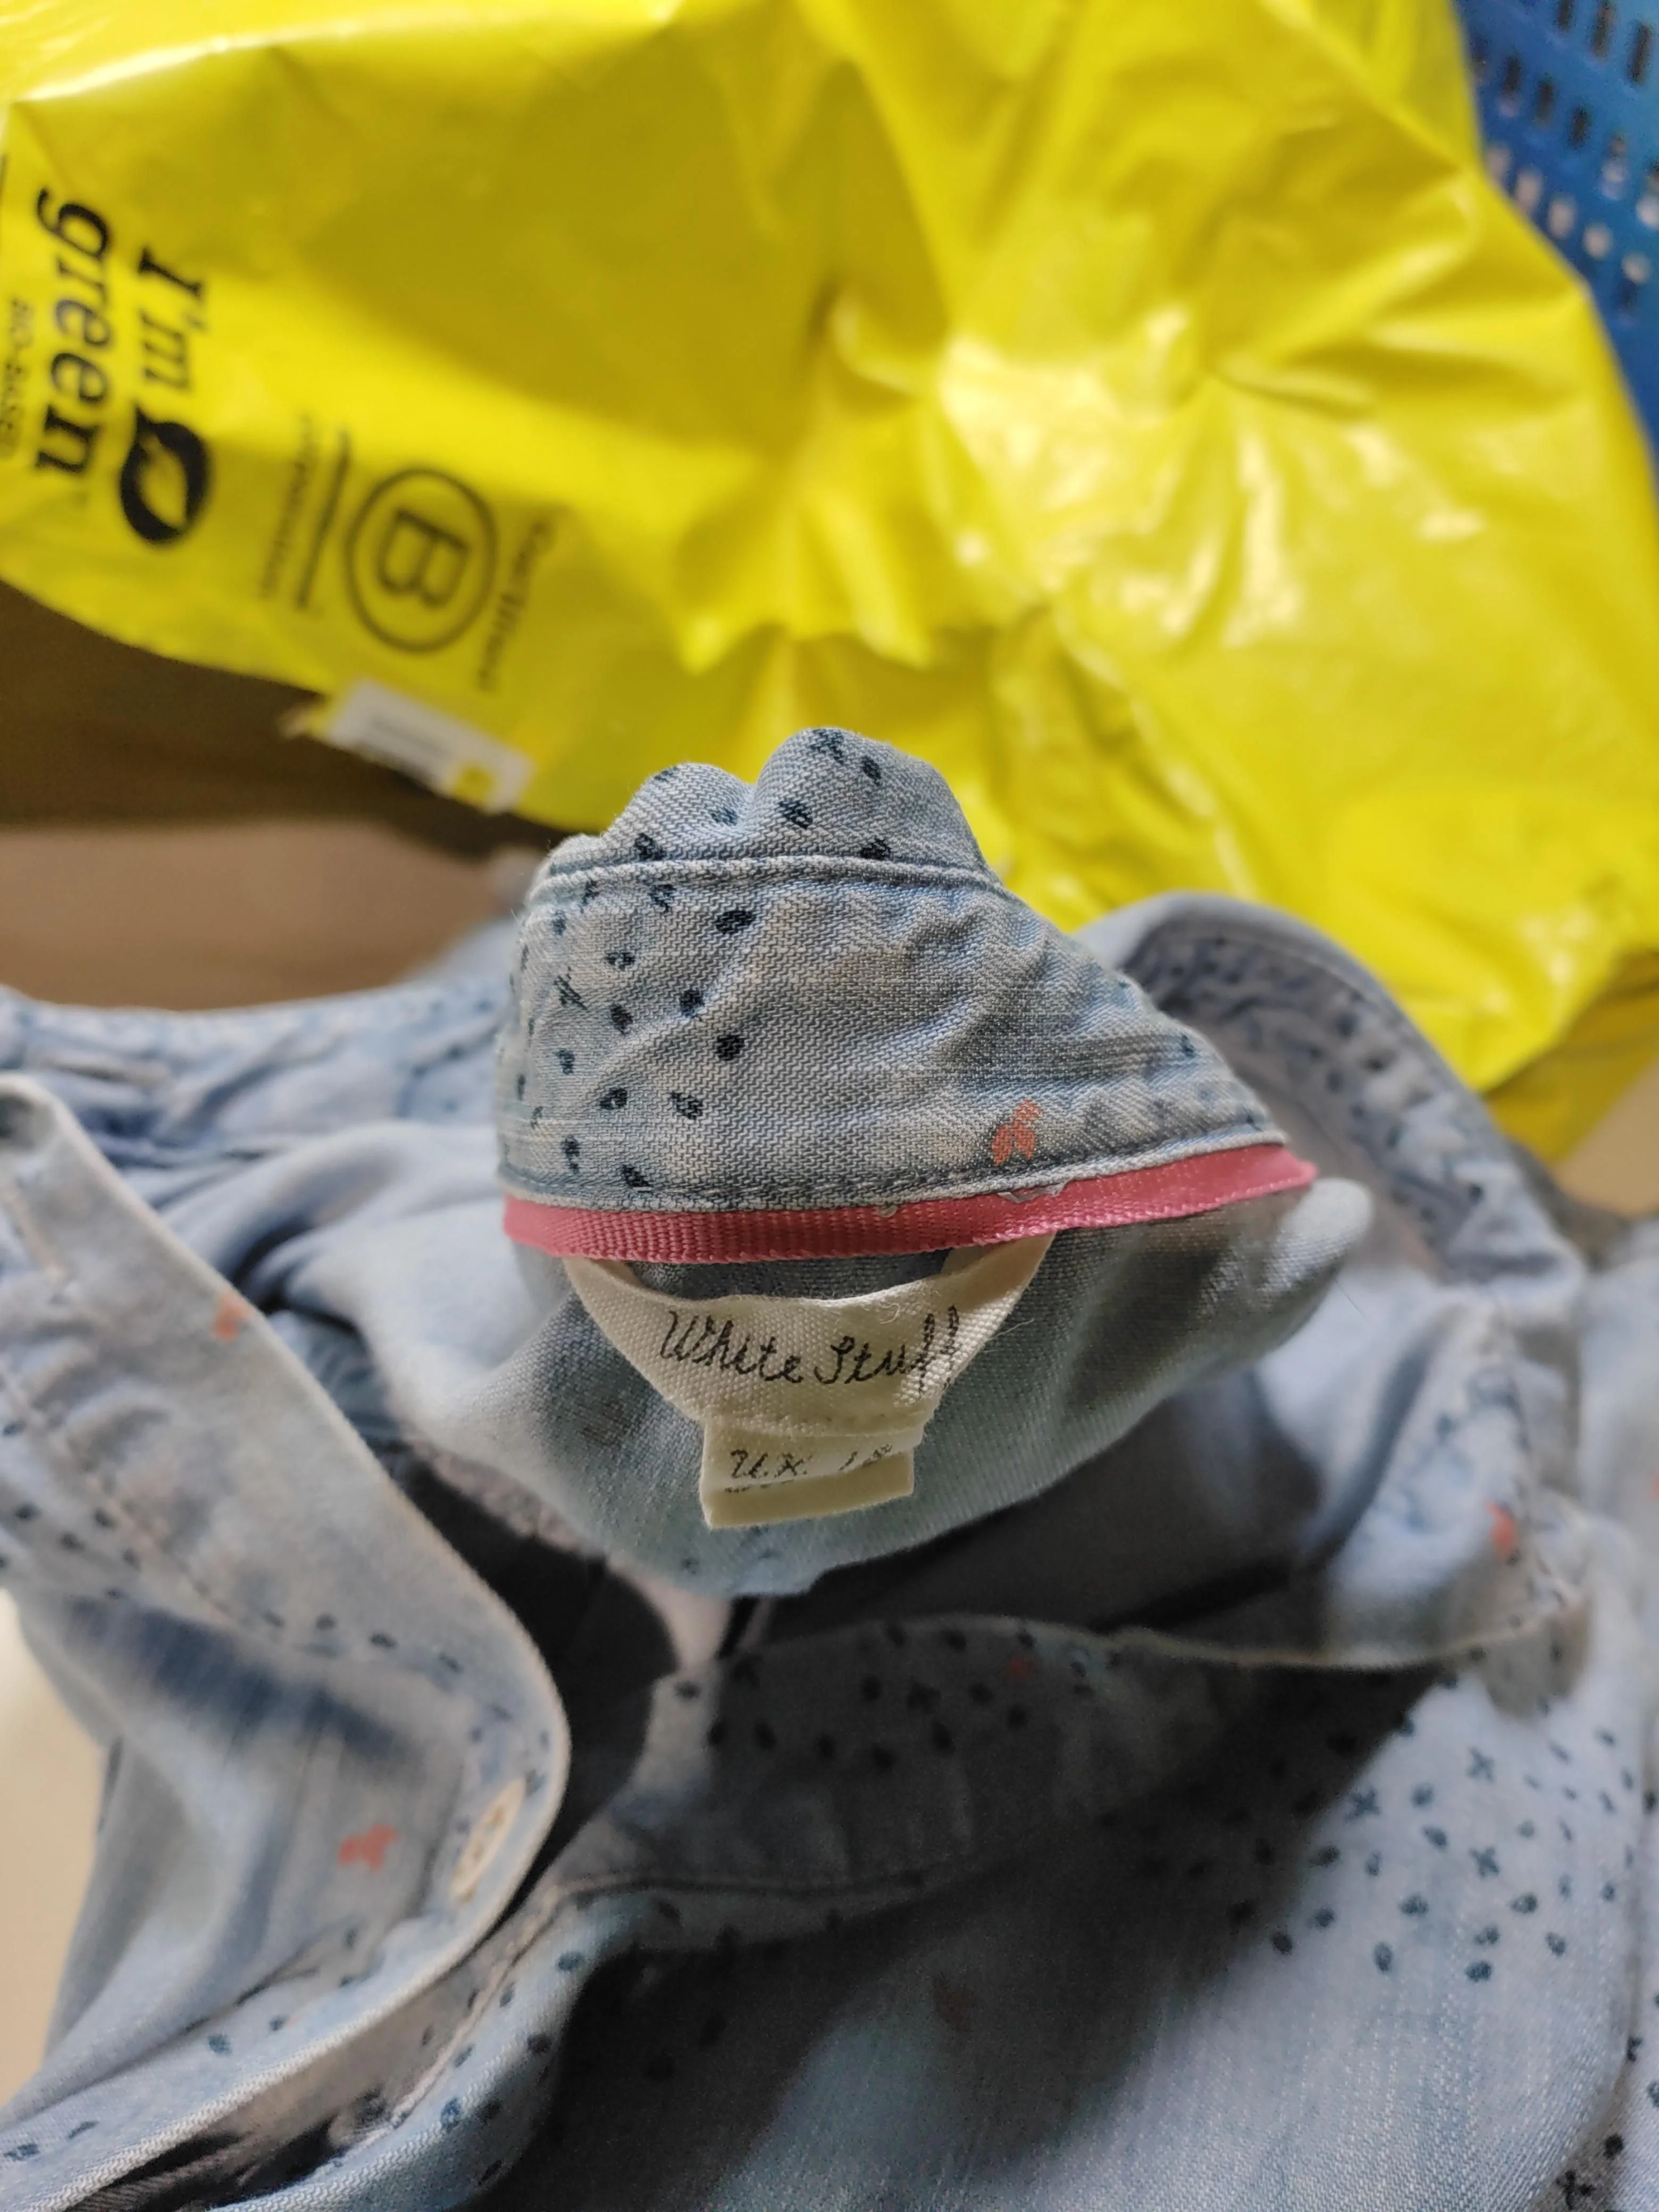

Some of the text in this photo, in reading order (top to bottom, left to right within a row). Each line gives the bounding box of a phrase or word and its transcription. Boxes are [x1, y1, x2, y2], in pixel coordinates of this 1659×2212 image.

[36, 187, 112, 475] green
[138, 245, 205, 392] I'm
[376, 508, 471, 608] B
[659, 1305, 959, 1394] White Stuff
